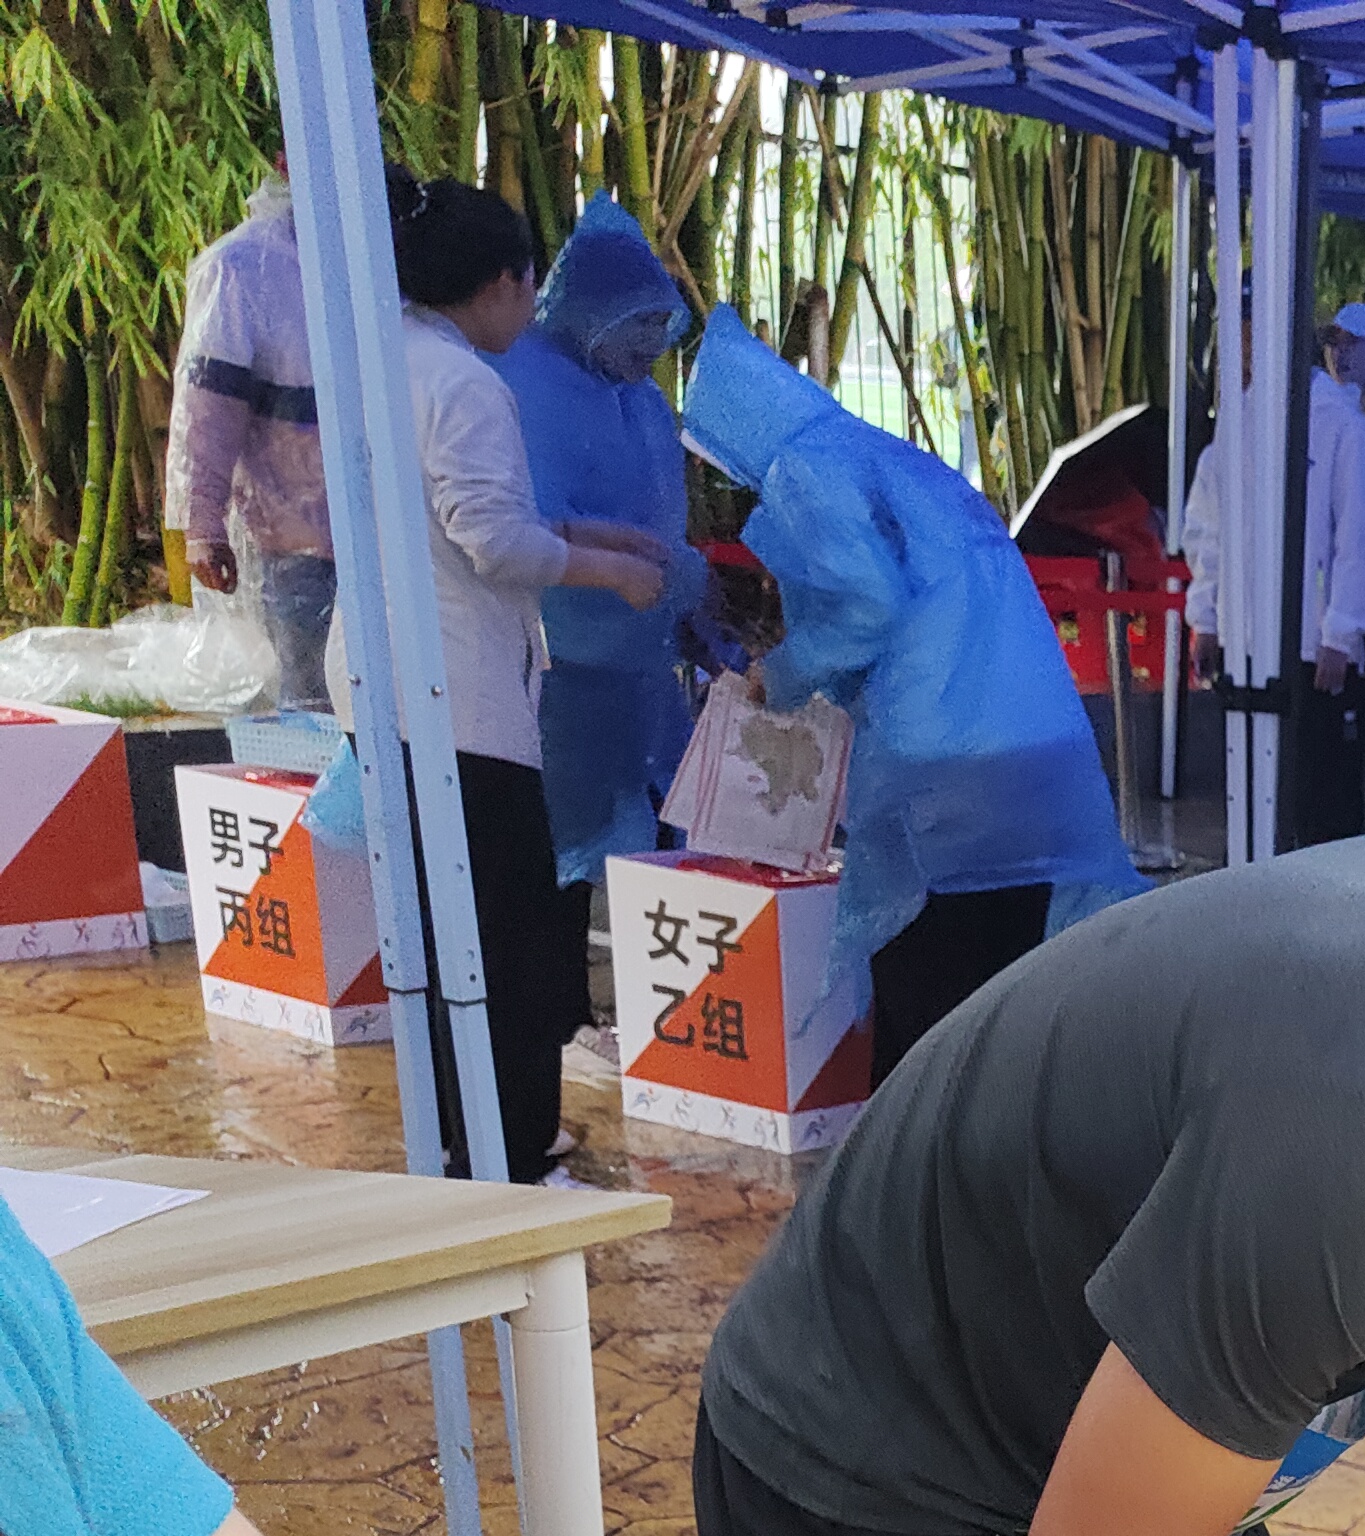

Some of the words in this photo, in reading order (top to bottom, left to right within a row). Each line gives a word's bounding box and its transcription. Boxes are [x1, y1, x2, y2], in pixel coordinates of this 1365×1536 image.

[208, 806, 285, 876] 男子
[215, 884, 297, 959] 丙组
[643, 898, 744, 975] 女子
[651, 982, 750, 1060] 乙组
